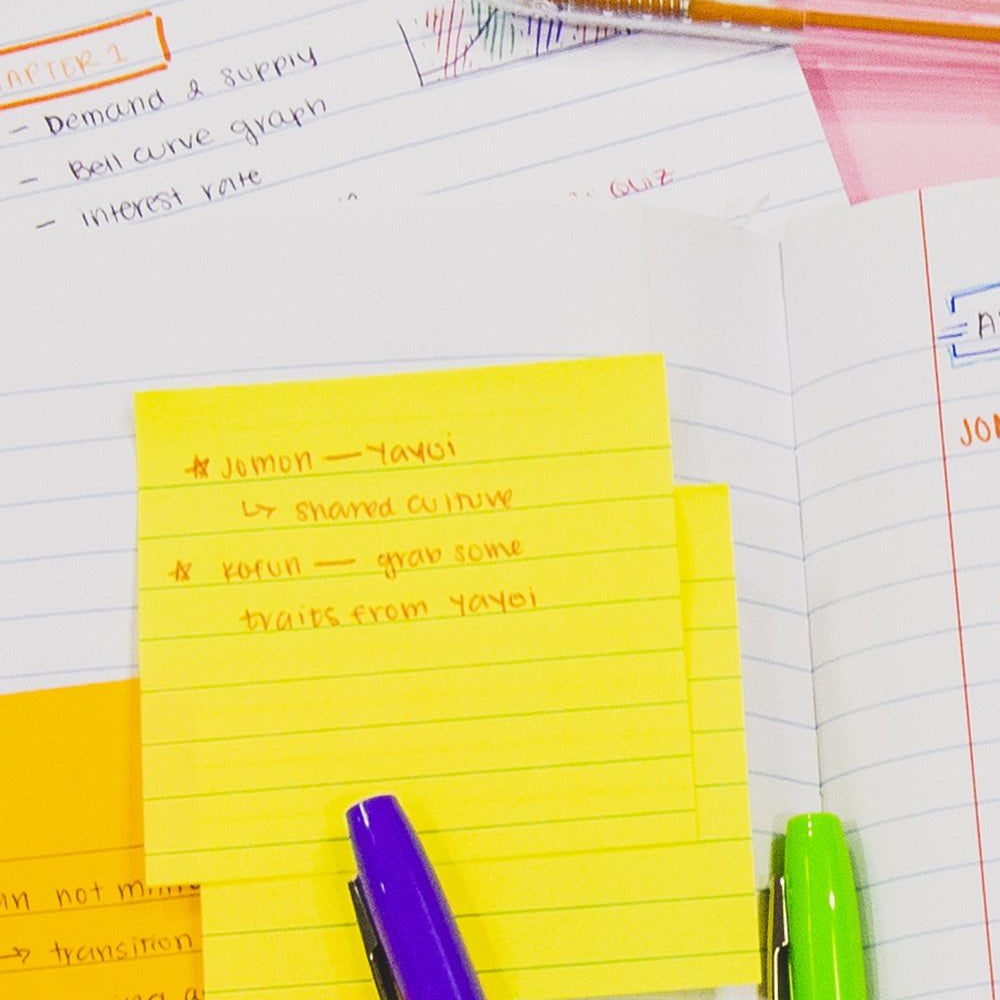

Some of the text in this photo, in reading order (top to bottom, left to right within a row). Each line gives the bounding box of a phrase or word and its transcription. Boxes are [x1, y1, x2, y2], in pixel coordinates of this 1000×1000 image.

[0, 42, 128, 92] APTER 1
[45, 89, 164, 135] Demand
[220, 46, 318, 87] supply
[68, 97, 327, 181] Bell curve graph
[82, 168, 263, 226] interest rate
[296, 487, 514, 522] shared culture
[377, 546, 442, 579] grab
[454, 540, 523, 561] some
[240, 602, 340, 632] traits
[351, 597, 428, 625] from
[56, 882, 103, 907] not
[51, 932, 194, 966] transition
